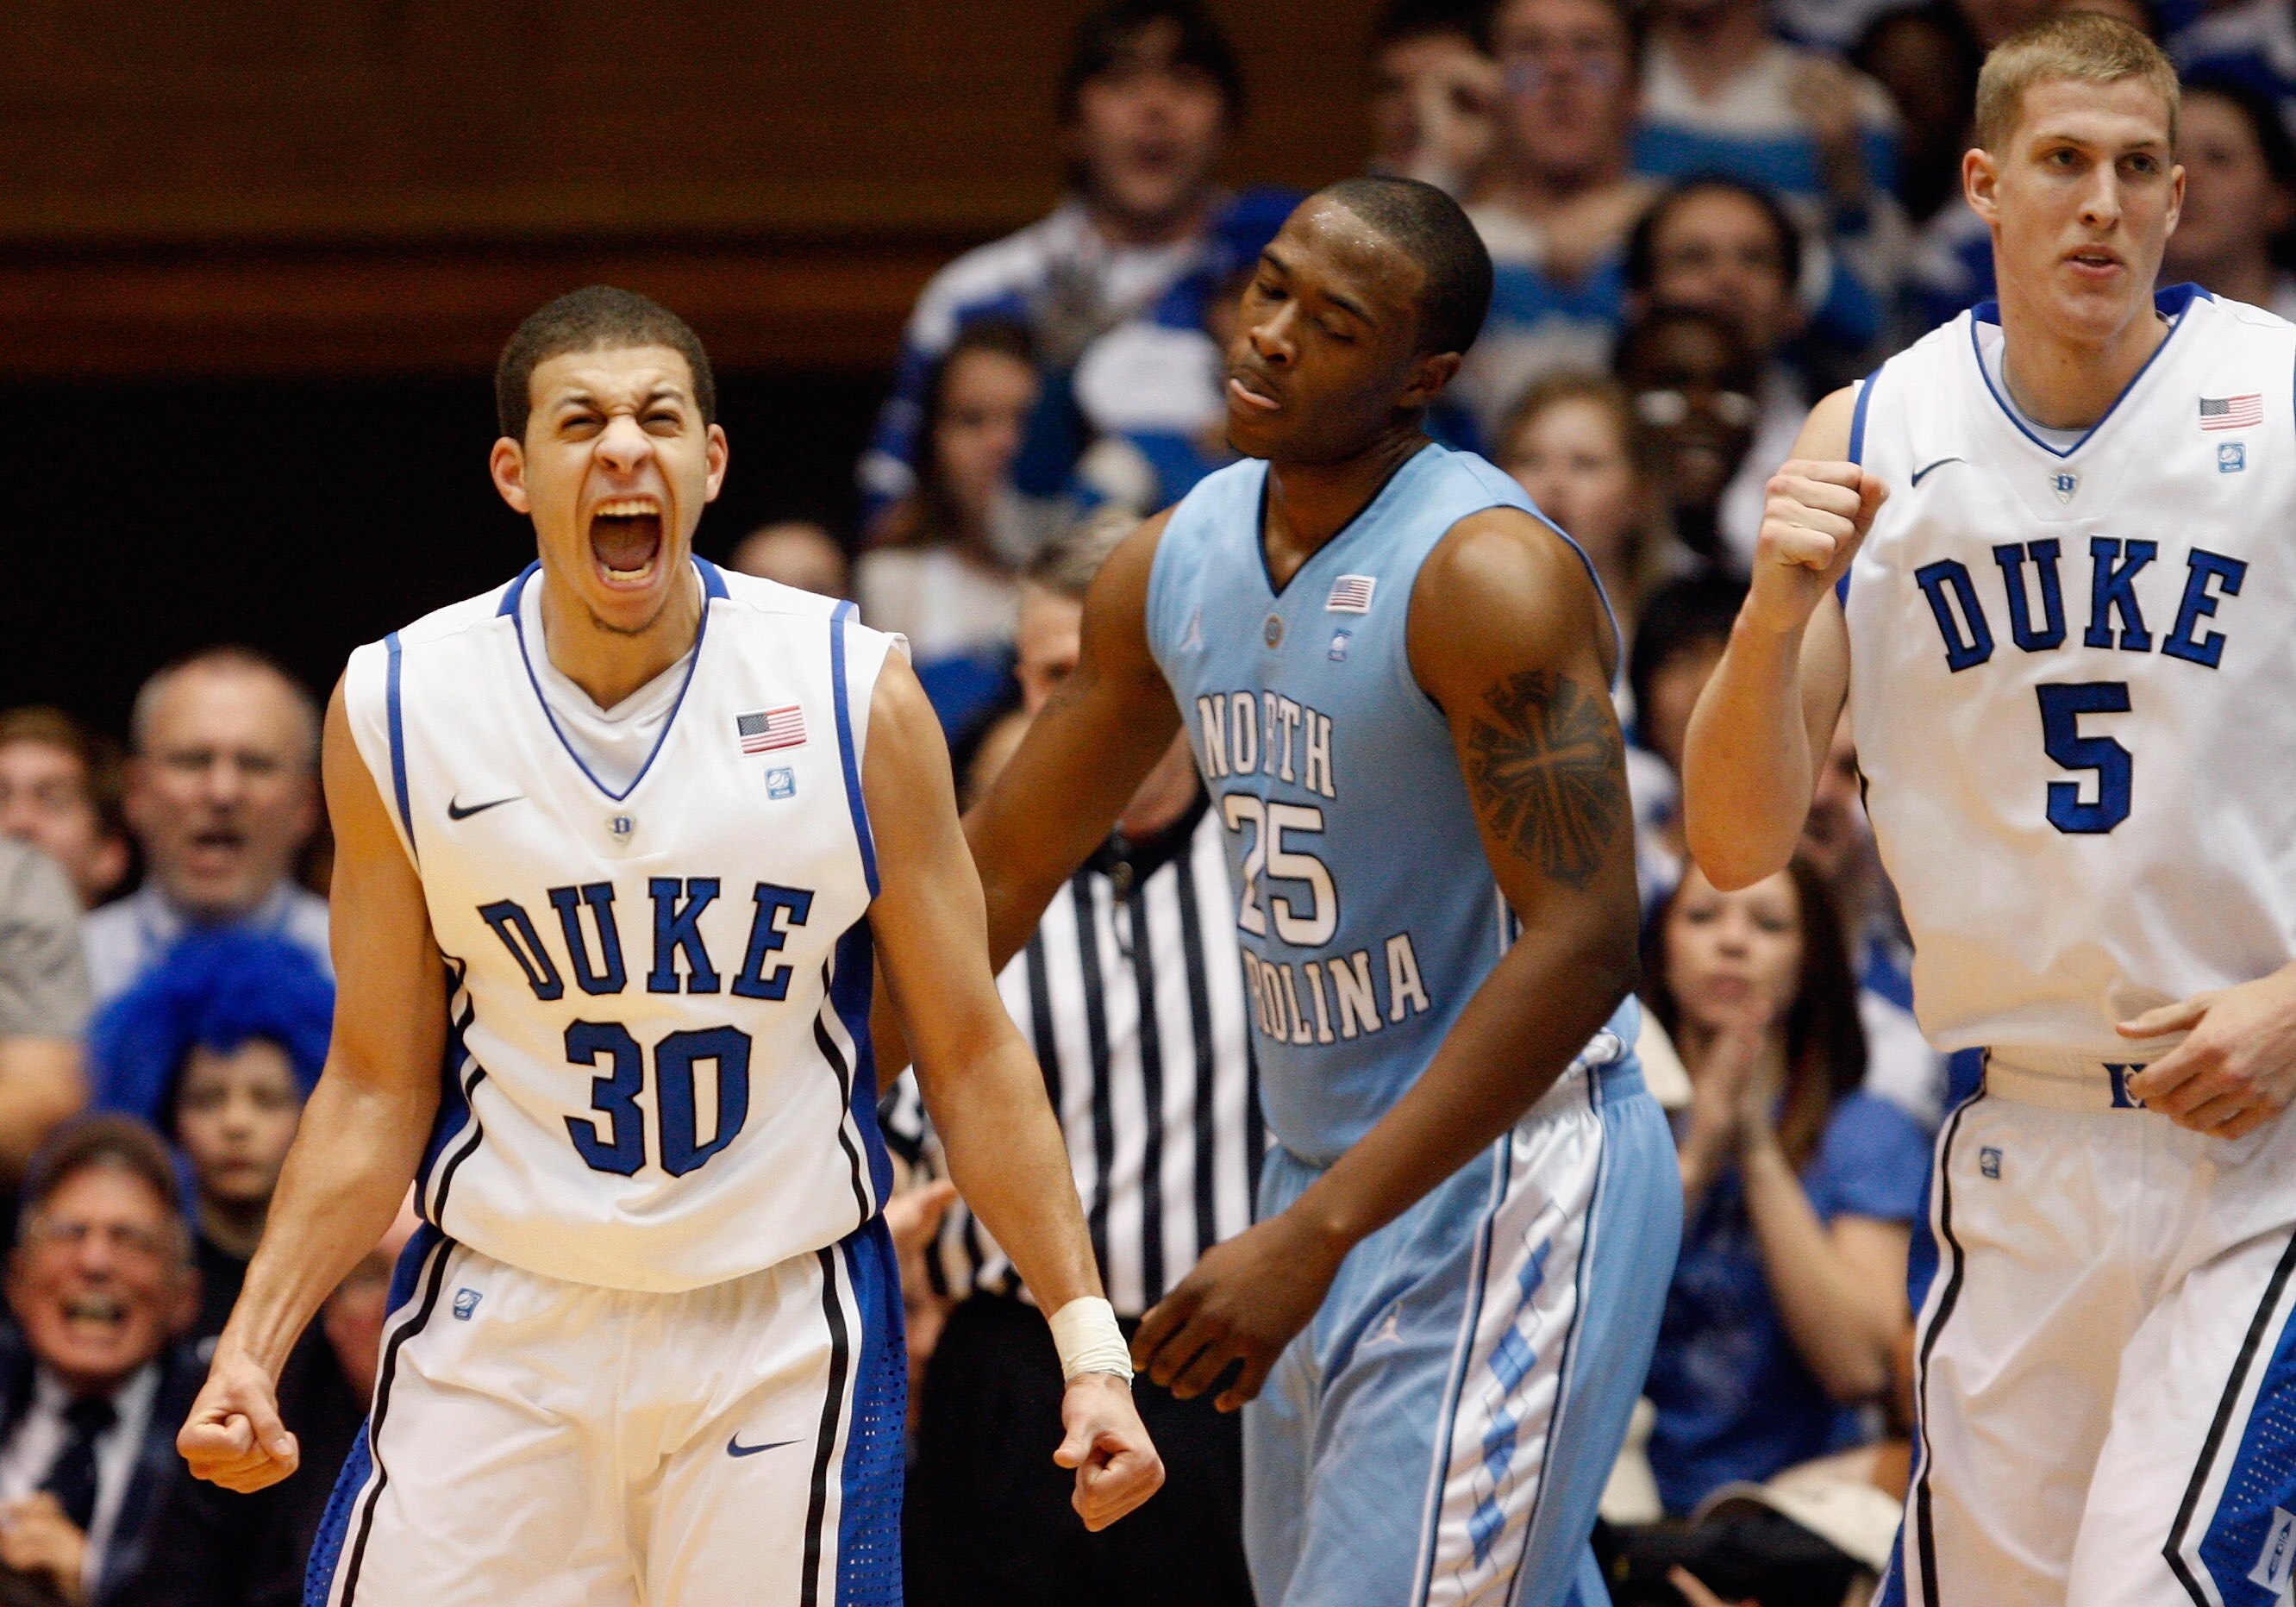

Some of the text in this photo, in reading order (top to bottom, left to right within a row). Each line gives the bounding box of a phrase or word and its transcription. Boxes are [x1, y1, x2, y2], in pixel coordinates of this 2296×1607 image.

[1914, 535, 2249, 672] DUKE
[2036, 681, 2132, 834] 5
[476, 877, 815, 1001] DUKE
[1223, 792, 1340, 947] 25
[563, 1017, 753, 1179] 30
